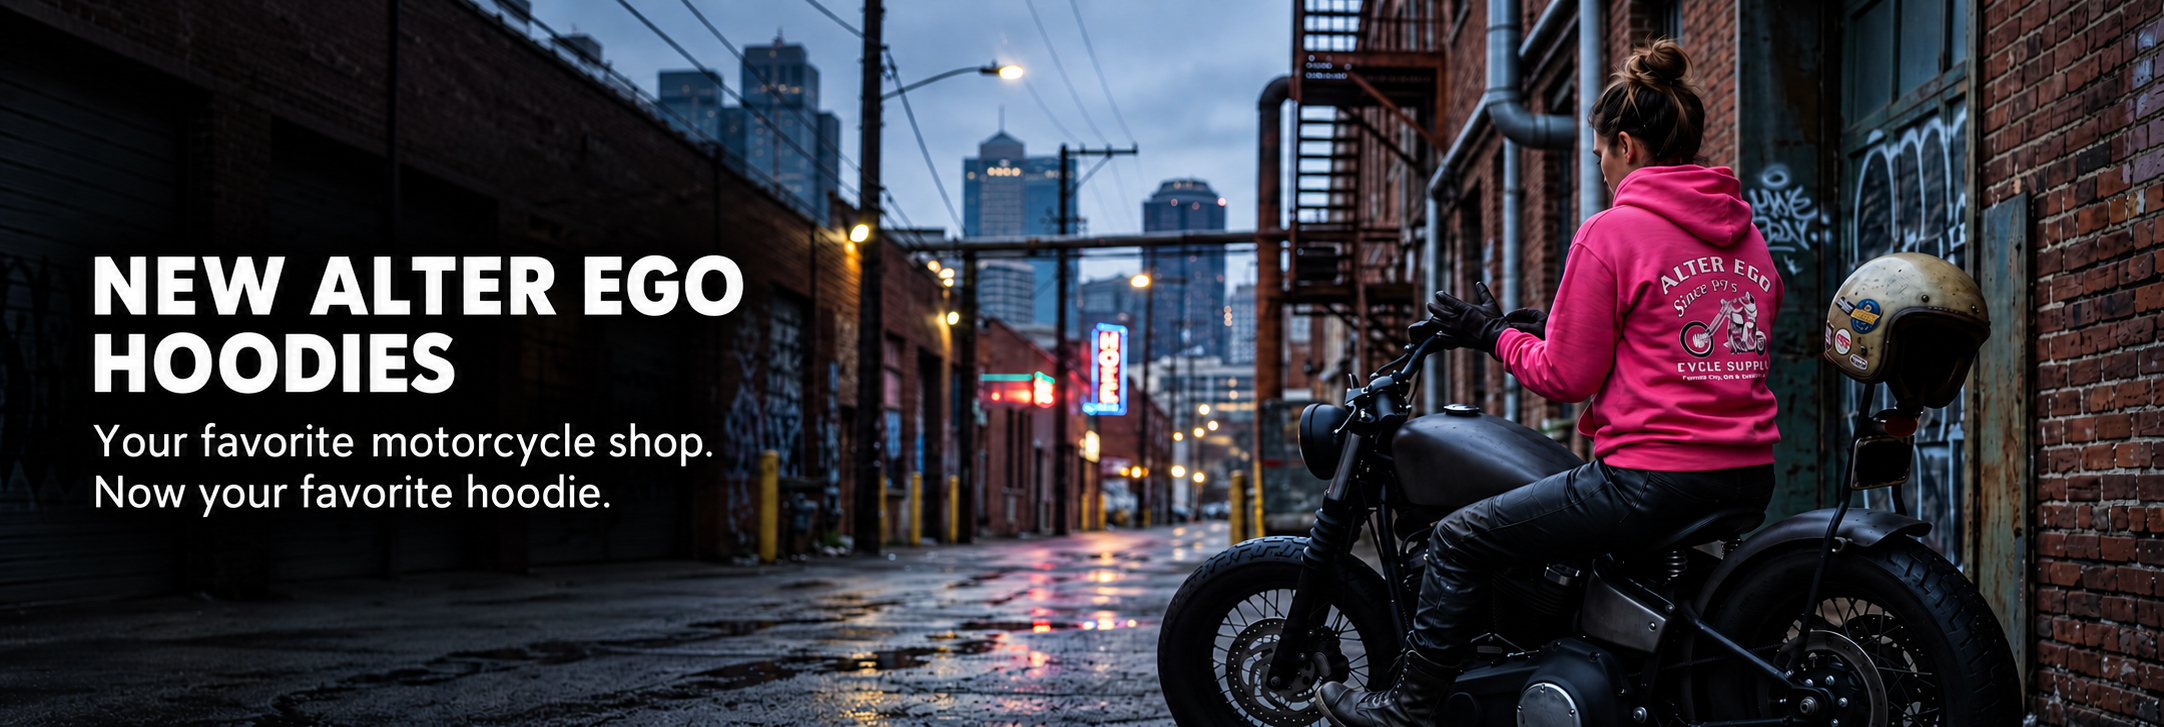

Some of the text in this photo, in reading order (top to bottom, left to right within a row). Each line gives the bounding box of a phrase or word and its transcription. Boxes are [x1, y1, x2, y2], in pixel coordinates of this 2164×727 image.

[1660, 256, 1771, 295] ALTER EGO
[1673, 283, 1707, 318] Since
